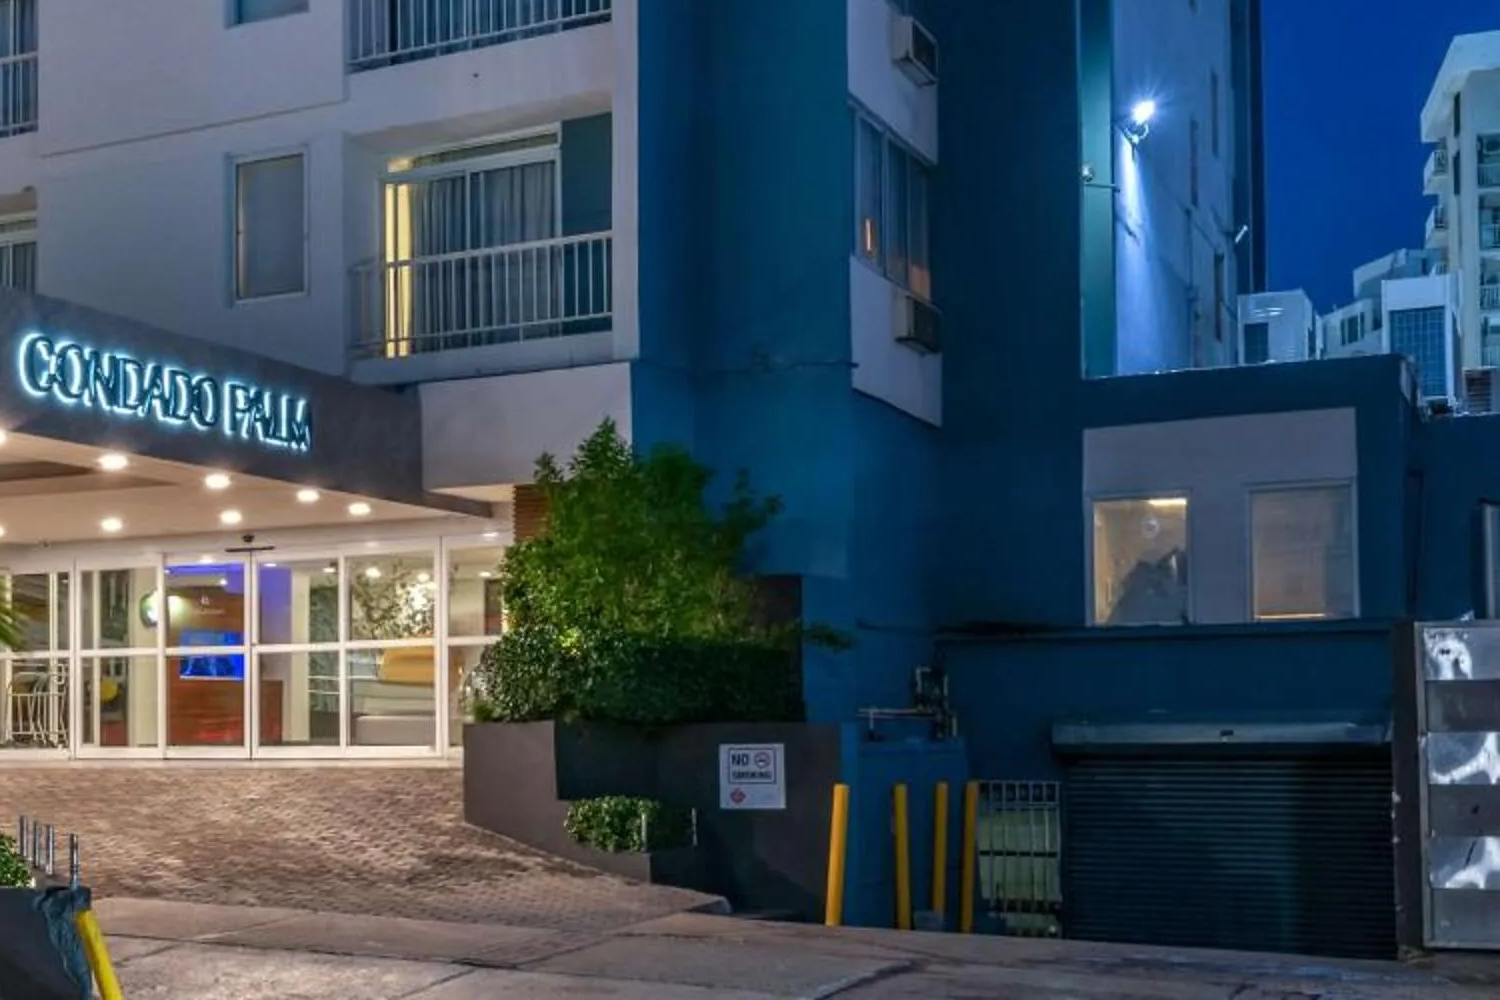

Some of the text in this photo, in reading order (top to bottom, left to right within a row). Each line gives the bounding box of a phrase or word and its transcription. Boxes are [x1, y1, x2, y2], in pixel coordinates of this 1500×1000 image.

[18, 333, 314, 453] CONDADO PALM
[731, 753, 749, 766] NO
